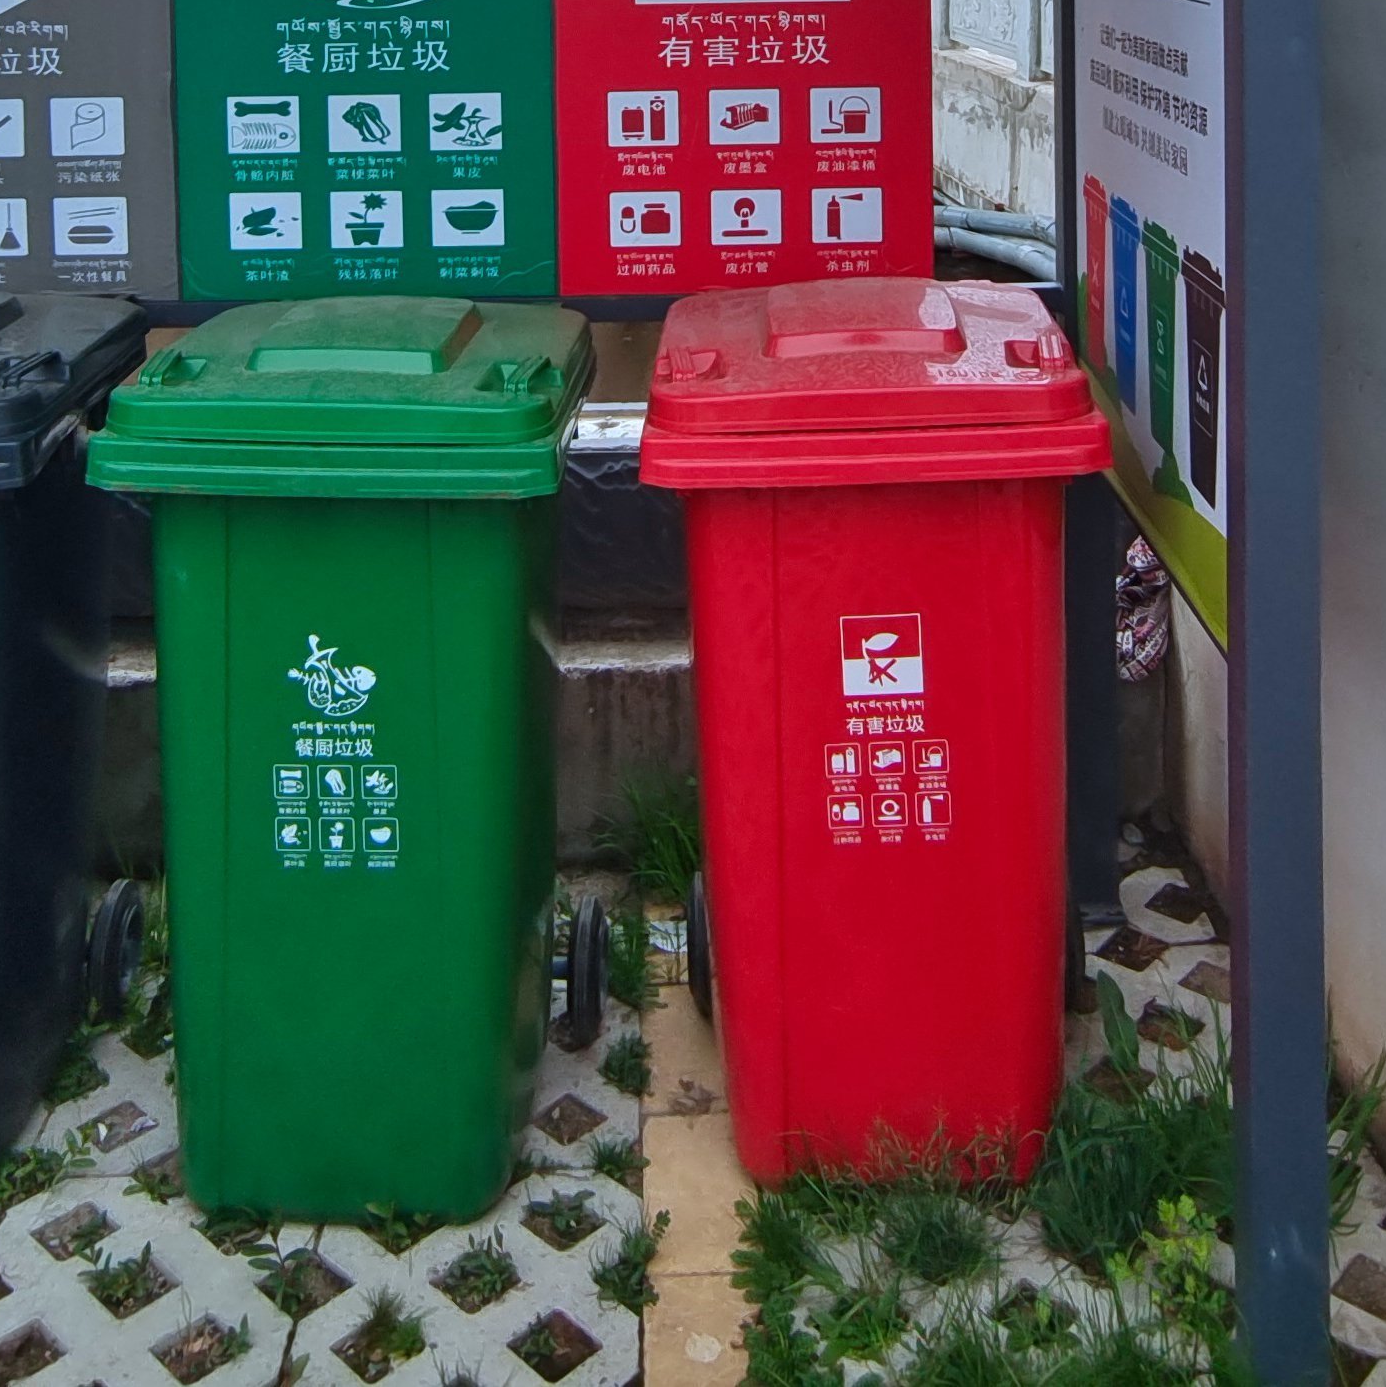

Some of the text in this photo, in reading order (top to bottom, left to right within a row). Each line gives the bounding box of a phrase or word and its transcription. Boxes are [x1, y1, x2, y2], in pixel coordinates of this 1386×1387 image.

[276, 40, 451, 74] 餐厨垃圾
[658, 35, 830, 68] 有害垃圾
[1172, 94, 1208, 137] 节约资源
[452, 167, 482, 179] 果皮
[622, 164, 667, 176] 废电池
[723, 162, 767, 174] 废墨盒
[616, 263, 676, 276] 过期药品
[725, 262, 768, 275] 废灯管
[826, 260, 869, 272] 杀虫剂
[58, 270, 127, 283] 一次性餐具
[846, 714, 925, 736] 有害垃圾
[295, 738, 374, 758] 餐厨垃圾
